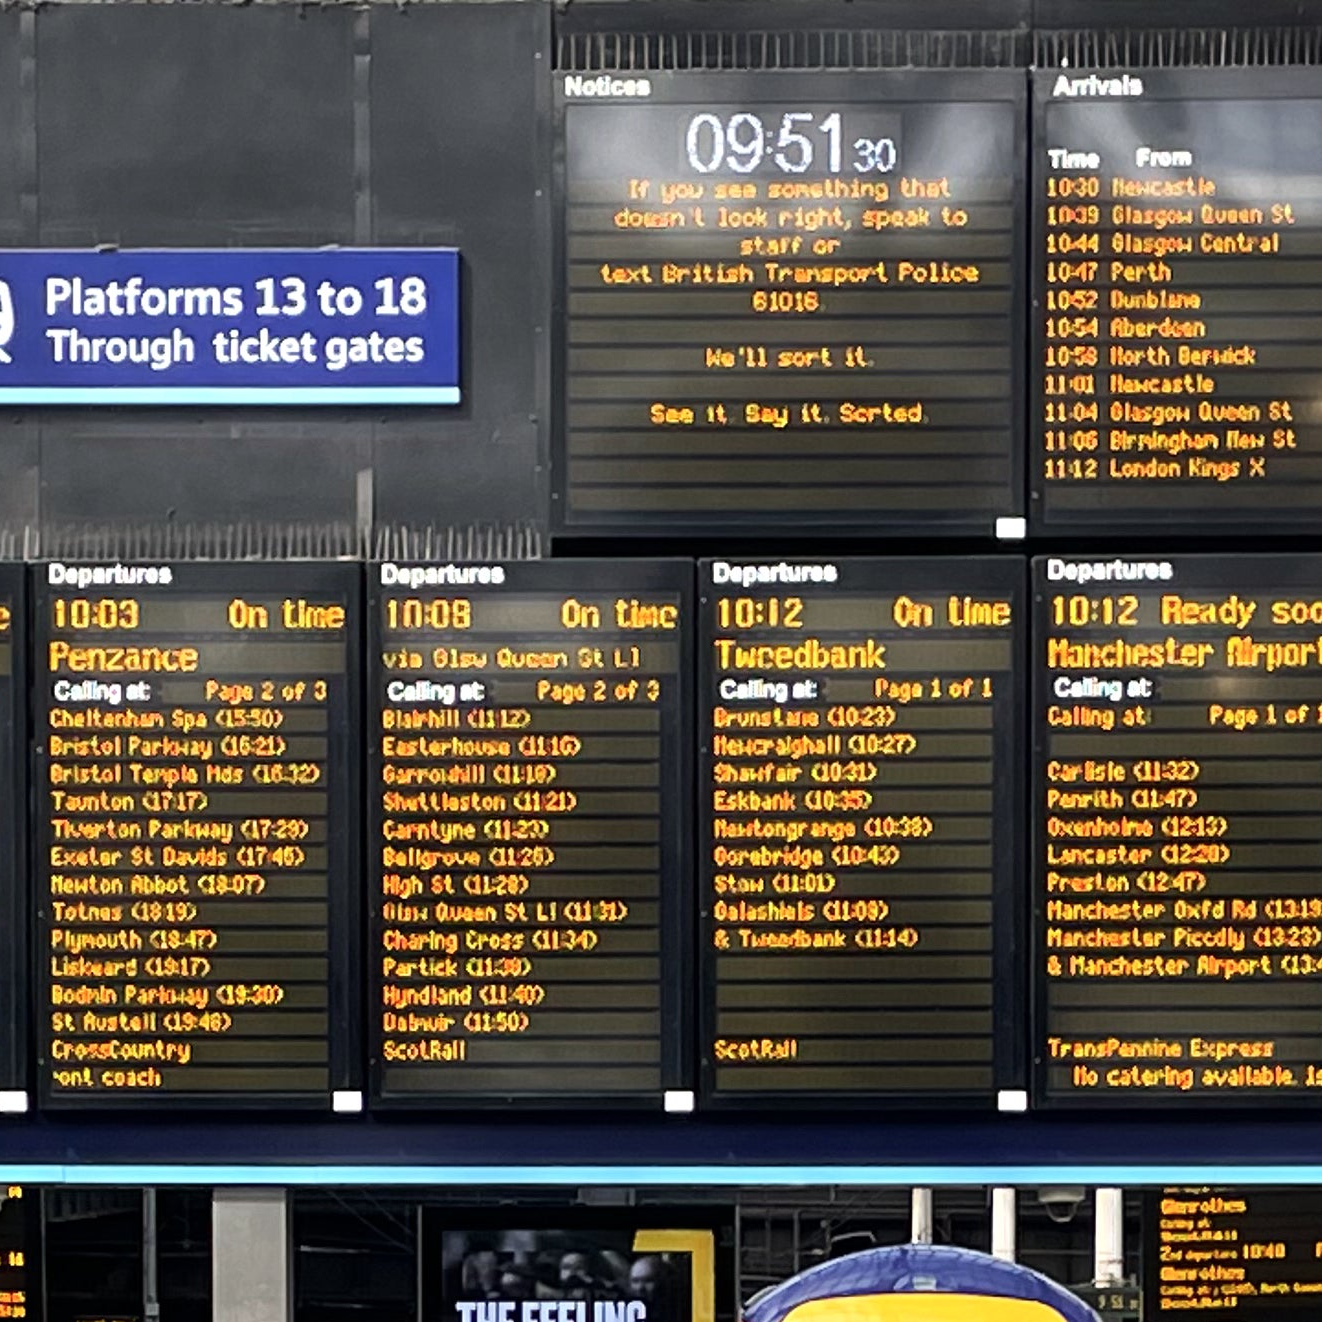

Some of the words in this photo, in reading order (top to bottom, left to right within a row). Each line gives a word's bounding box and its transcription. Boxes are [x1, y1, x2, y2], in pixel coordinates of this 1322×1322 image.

[564, 75, 651, 97] Notices
[1052, 74, 1144, 97] Arrivals
[686, 112, 842, 175] 09:51
[853, 138, 897, 173] 30
[1047, 148, 1101, 169] Time
[1135, 148, 1193, 168] From
[659, 182, 705, 205] you
[713, 182, 757, 200] see
[767, 178, 889, 203] something
[899, 177, 951, 199] that
[717, 206, 769, 228] look
[861, 207, 930, 231] speak
[940, 206, 968, 226] to
[740, 235, 803, 256] staff
[812, 238, 841, 256] or
[599, 263, 653, 284] text
[764, 261, 889, 287] Transport
[46, 276, 244, 317] Platforms
[255, 277, 307, 317] 13
[316, 281, 363, 317] to
[374, 276, 427, 316] 18
[45, 327, 195, 371] Through
[212, 327, 318, 364] ticket
[325, 331, 425, 371] gates
[777, 347, 832, 368] sort
[650, 402, 695, 424] See
[745, 403, 789, 428] Say
[48, 562, 173, 589] Departures
[380, 562, 506, 590] Departures
[712, 561, 838, 588] Departures
[1047, 558, 1174, 585] Departures
[228, 598, 269, 629] On
[281, 599, 345, 629] time
[718, 597, 804, 629] 10:12
[893, 595, 933, 628] On
[948, 595, 1011, 627] time
[1052, 595, 1139, 627] 10:12
[1161, 594, 1257, 630] Ready
[49, 641, 199, 672] Penzance
[1047, 637, 1215, 669] Manchester
